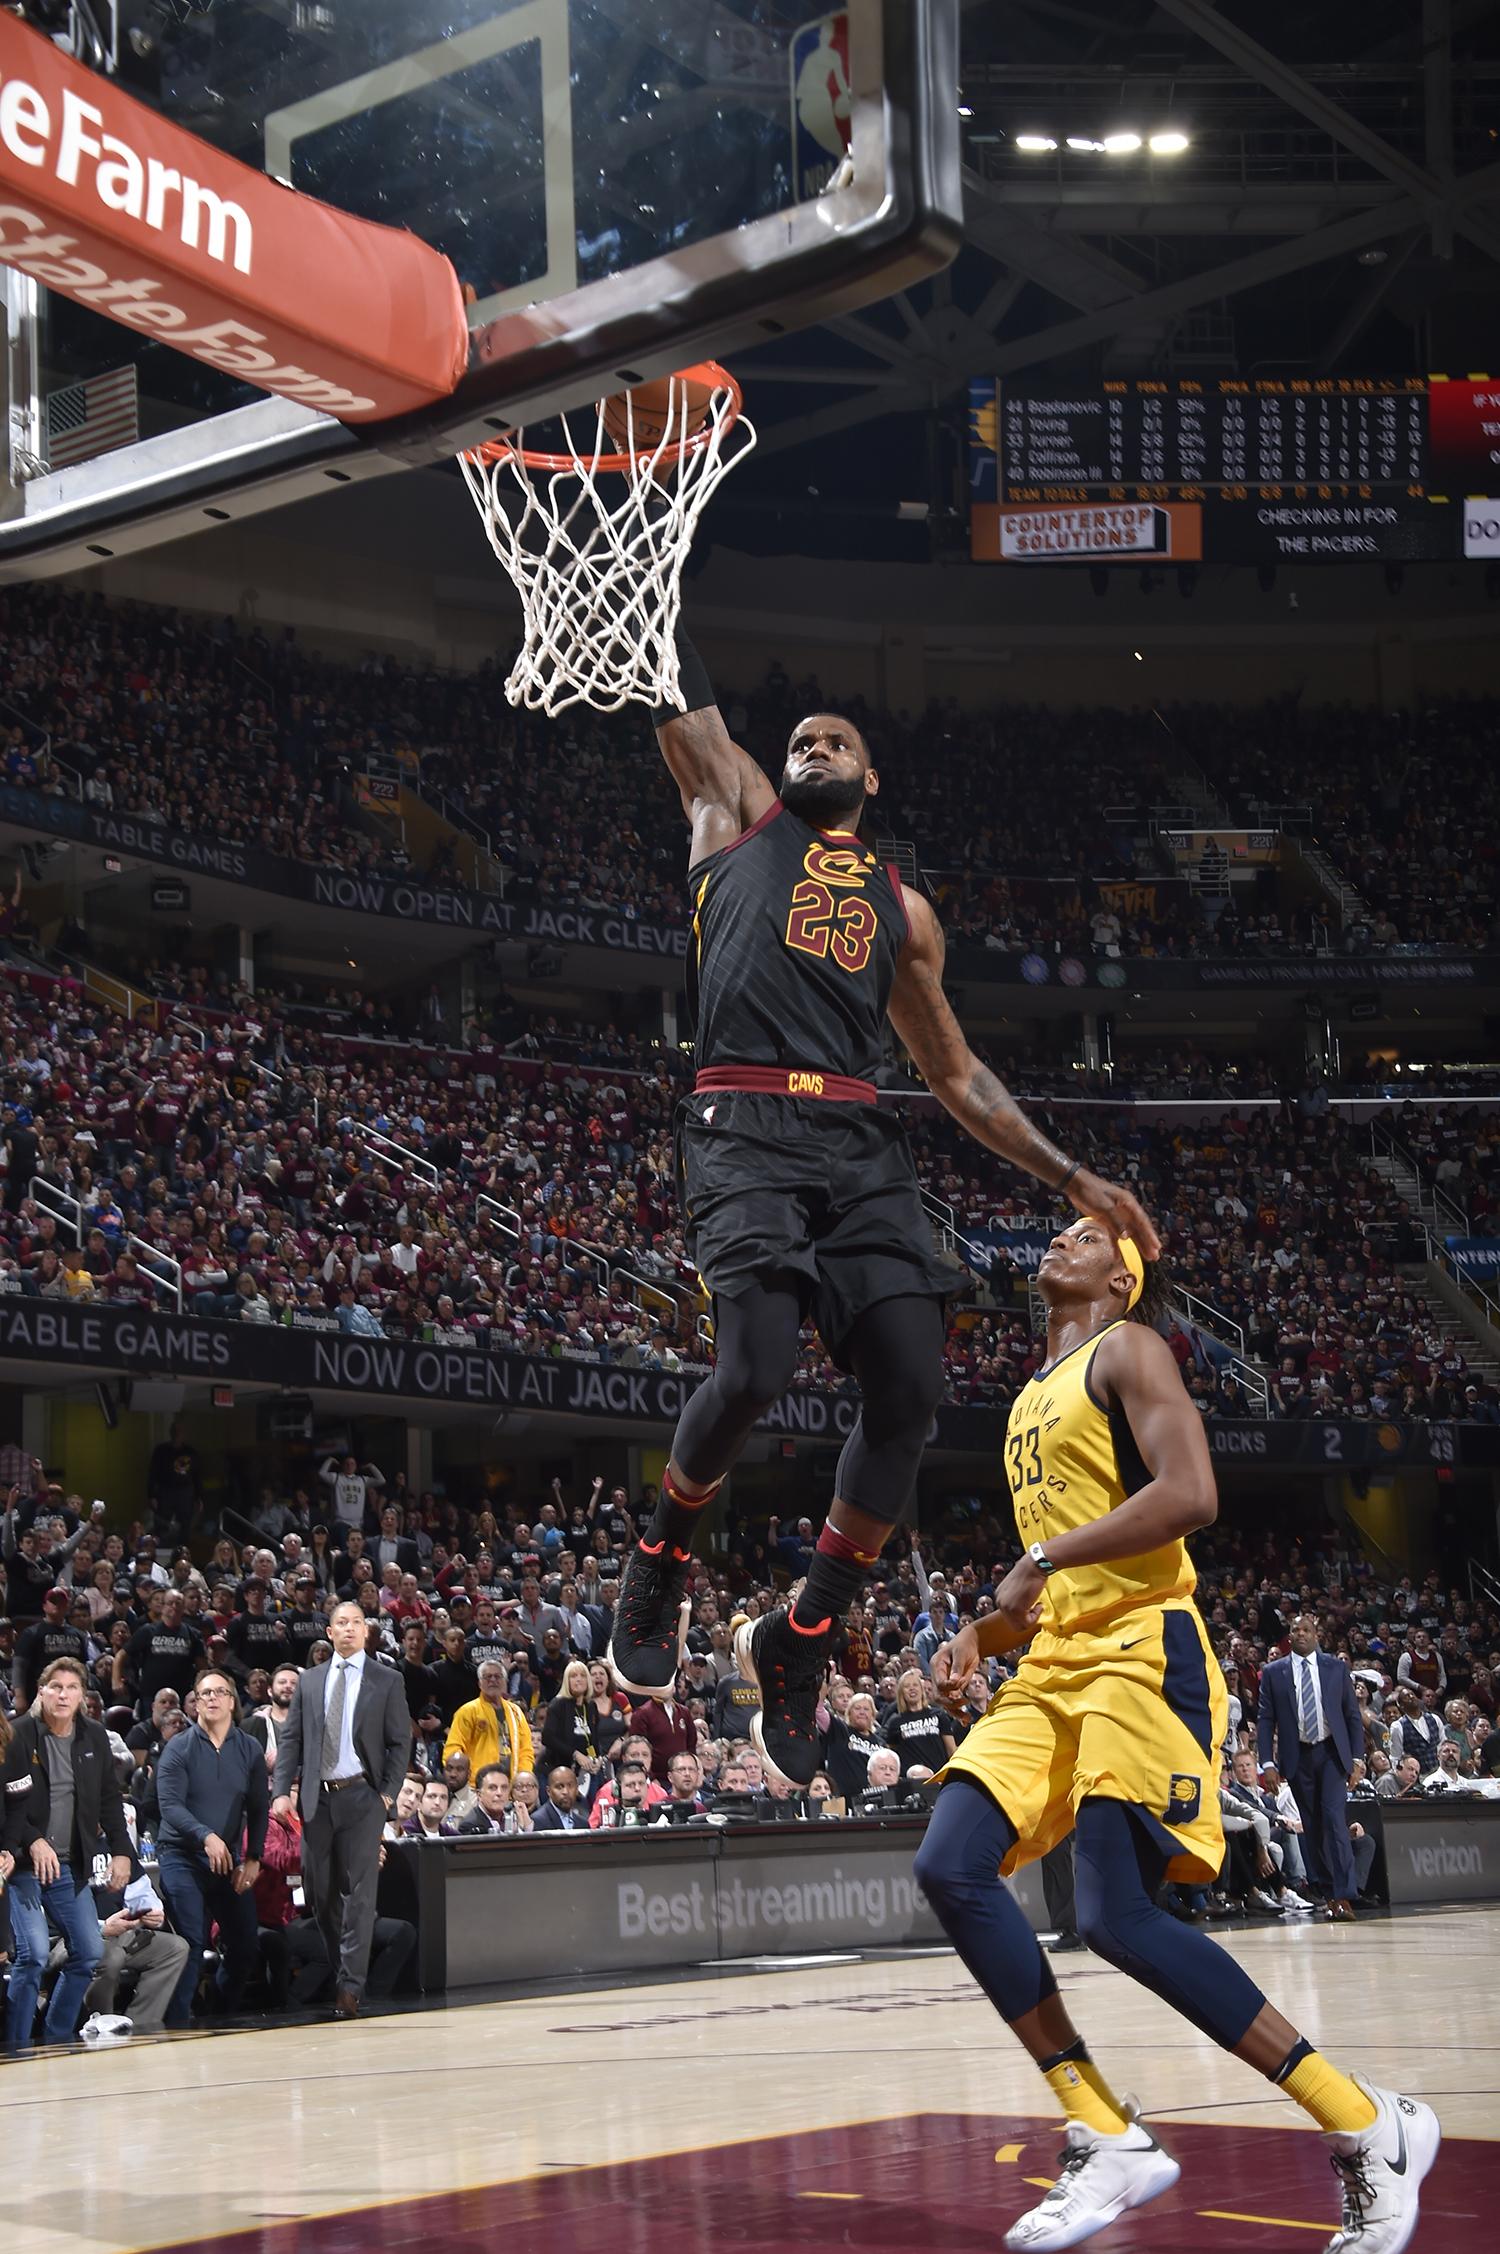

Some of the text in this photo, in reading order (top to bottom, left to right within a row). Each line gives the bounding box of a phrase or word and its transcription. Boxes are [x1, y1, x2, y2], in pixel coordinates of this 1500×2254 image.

[56, 88, 253, 276] Farm
[168, 319, 377, 412] Farm
[1006, 399, 1023, 414] 44
[1027, 399, 1103, 414] Bogdanovic
[1028, 416, 1069, 432] Young
[1006, 433, 1024, 448] 33
[1028, 433, 1074, 448] Turner
[1028, 449, 1080, 464] Collison
[1007, 465, 1024, 481] 40
[1028, 465, 1088, 481] Robinson
[1005, 508, 1152, 534] COUNTERTOP
[1256, 508, 1400, 525] CHECKING IN FOR
[1017, 529, 1138, 551] SOLUTIONS
[1275, 536, 1310, 553] THE
[90, 815, 247, 877] TABLE GAMES
[314, 872, 688, 956] NOW OPEN AT JACK CLEVE
[785, 879, 878, 973] 23
[788, 1072, 824, 1095] CAVS
[114, 1321, 231, 1365] GAMES
[313, 1343, 406, 1392] NOW
[414, 1352, 511, 1402] OPEN
[519, 1362, 560, 1406] AT
[568, 1368, 651, 1413] JACK
[1006, 1394, 1061, 1438] DIANA
[1008, 1425, 1043, 1494] 33
[1209, 1427, 1342, 1460] OCKS 2
[1017, 1473, 1068, 1529] CERS
[862, 1785, 889, 1796] SAMSUNG
[1407, 1837, 1483, 1878] verizon
[616, 1868, 888, 1938] Best streaming
